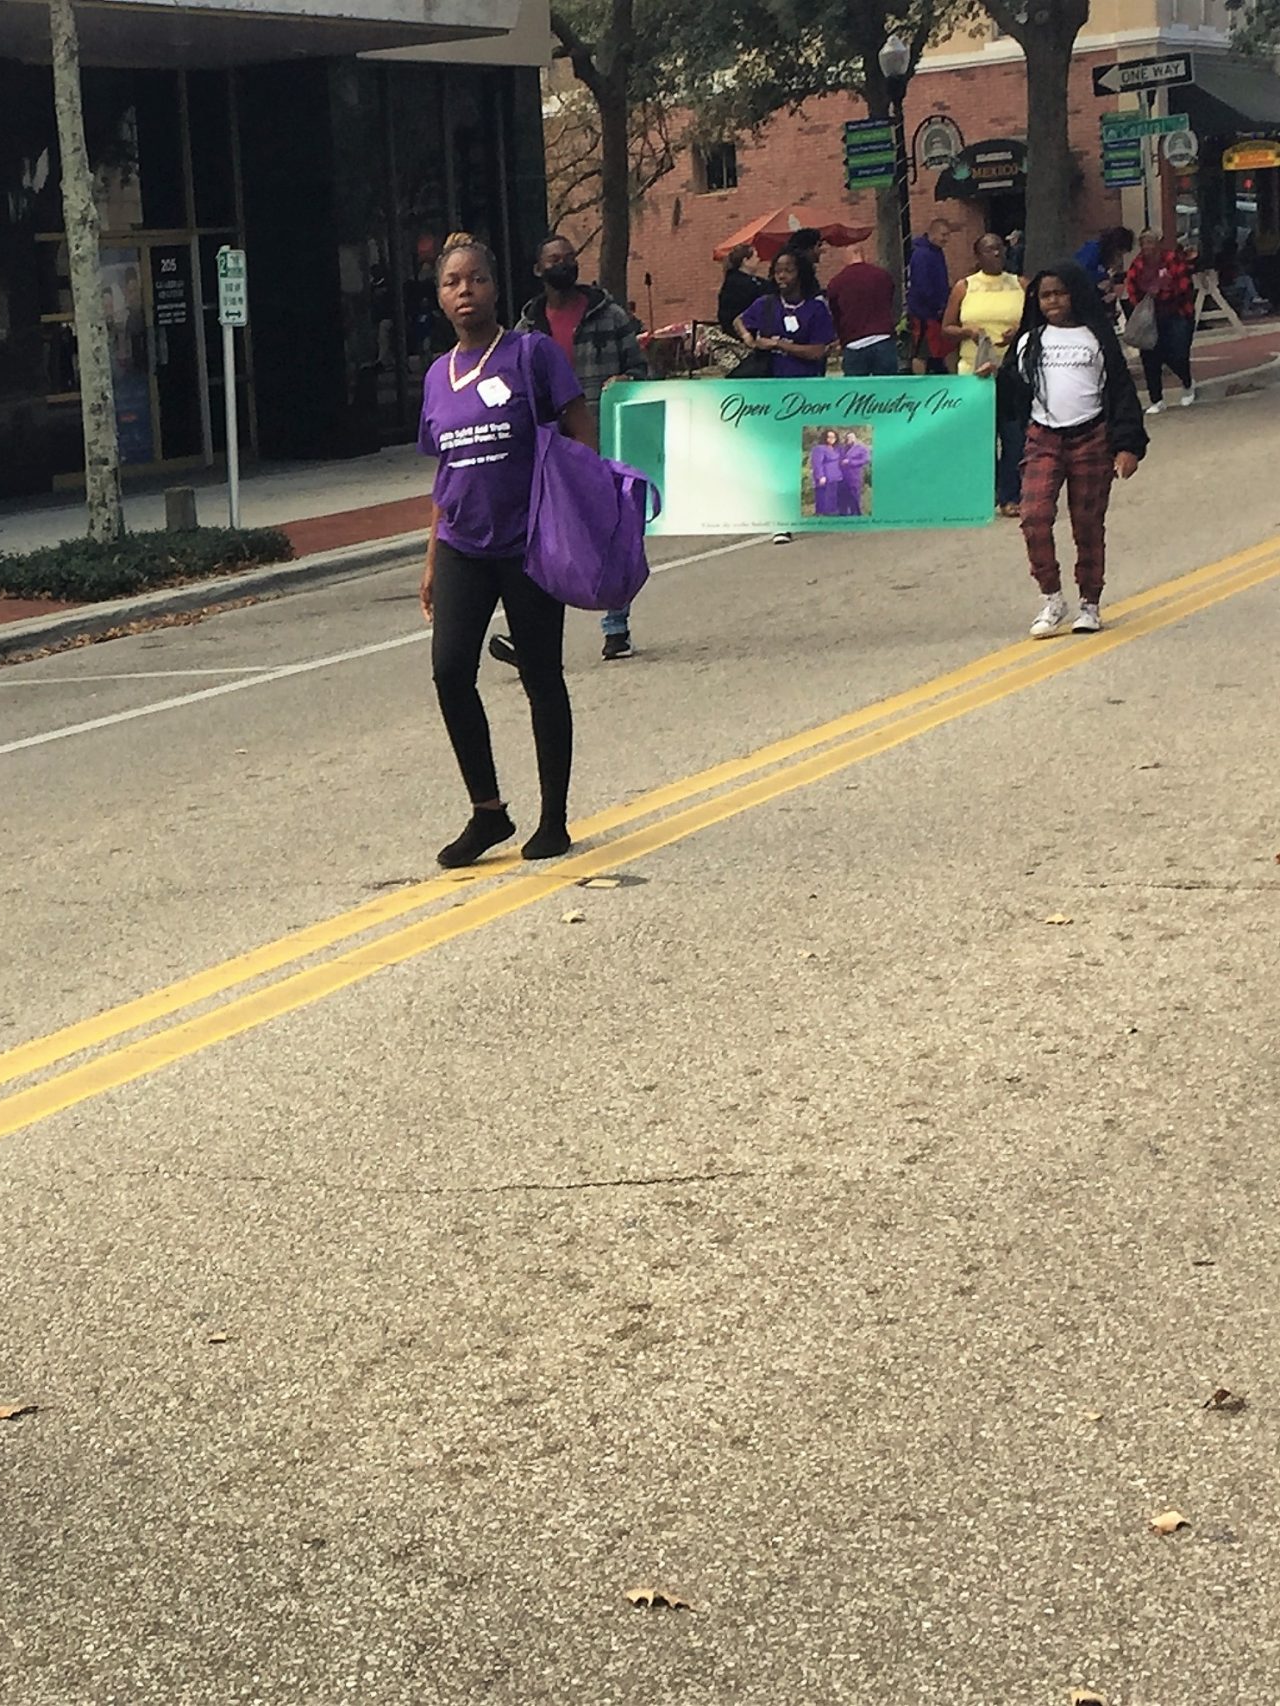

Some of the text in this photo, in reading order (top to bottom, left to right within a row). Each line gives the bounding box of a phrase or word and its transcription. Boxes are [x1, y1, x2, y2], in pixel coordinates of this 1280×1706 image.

[1122, 63, 1181, 83] ONE WAY
[720, 388, 963, 428] Open Door Ministry Inc
